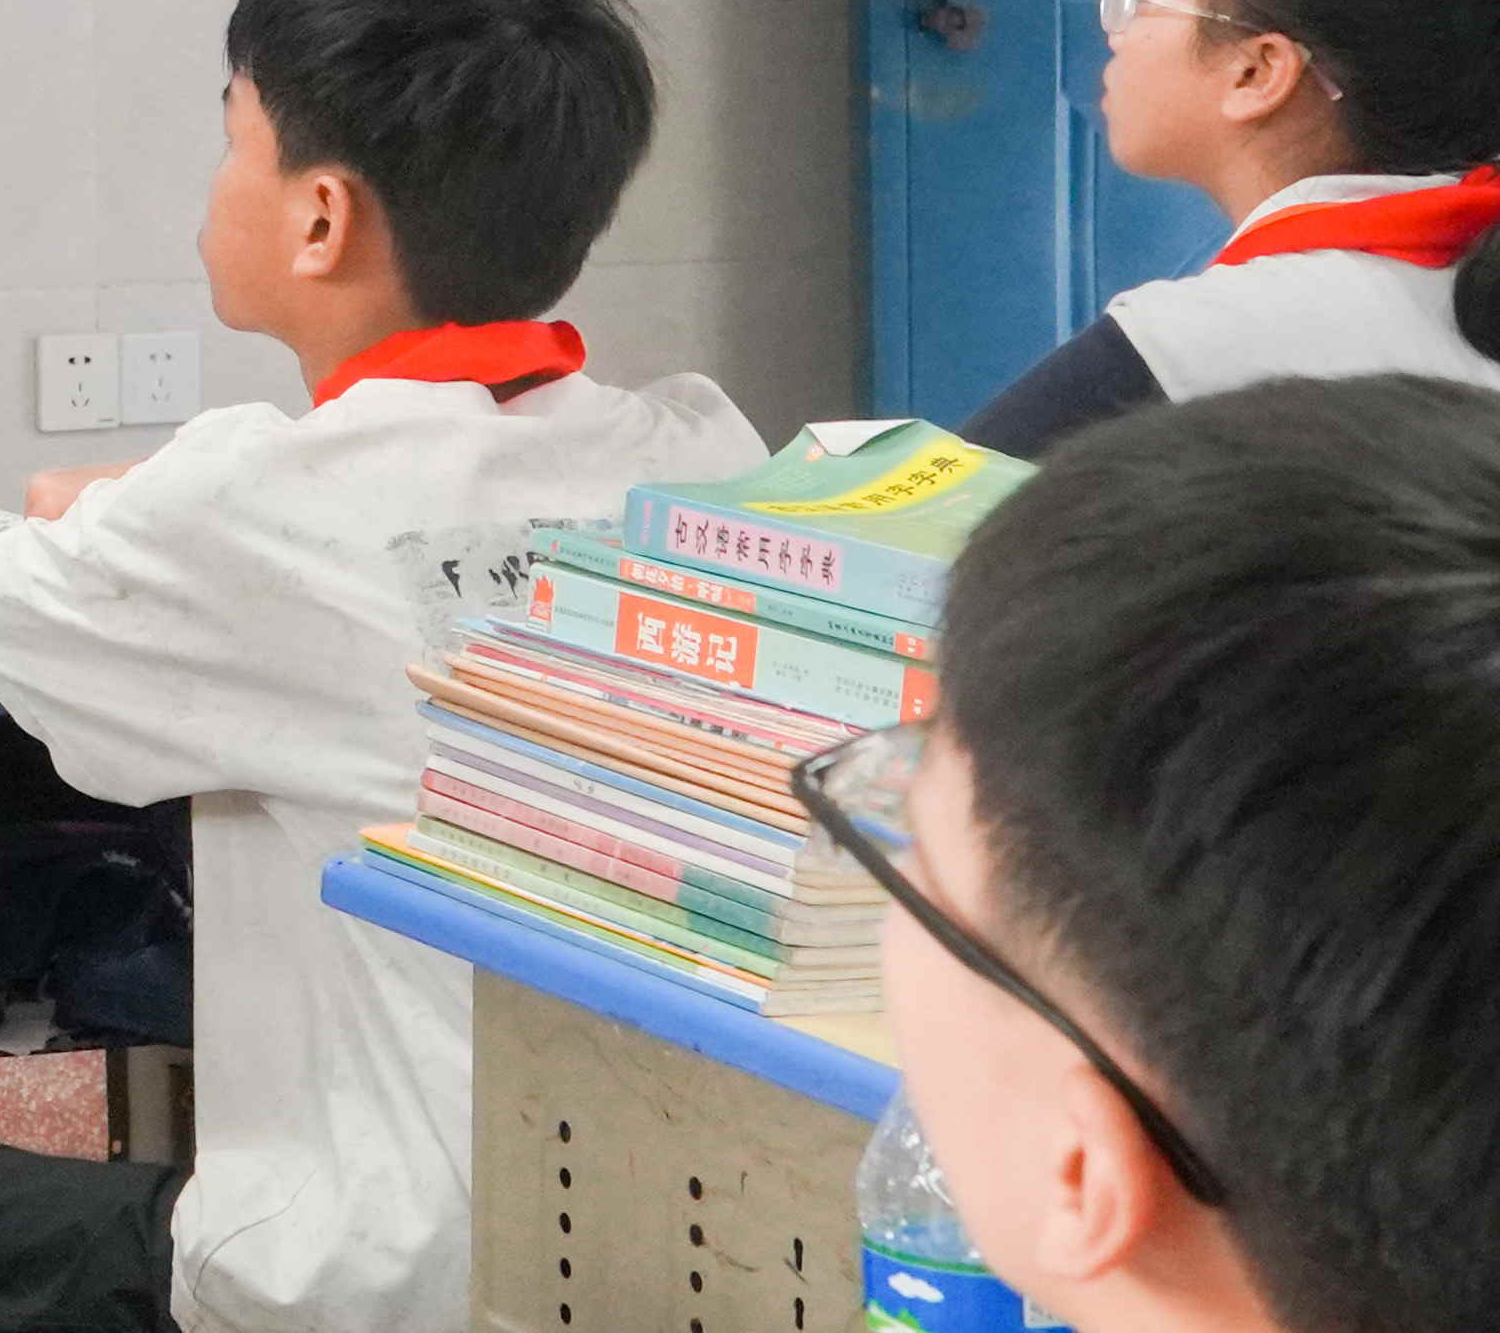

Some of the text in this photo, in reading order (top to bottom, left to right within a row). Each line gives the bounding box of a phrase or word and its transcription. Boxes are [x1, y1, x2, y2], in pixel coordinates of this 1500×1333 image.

[674, 513, 836, 585] 古汉语常用字字典
[636, 612, 739, 674] 西游记
